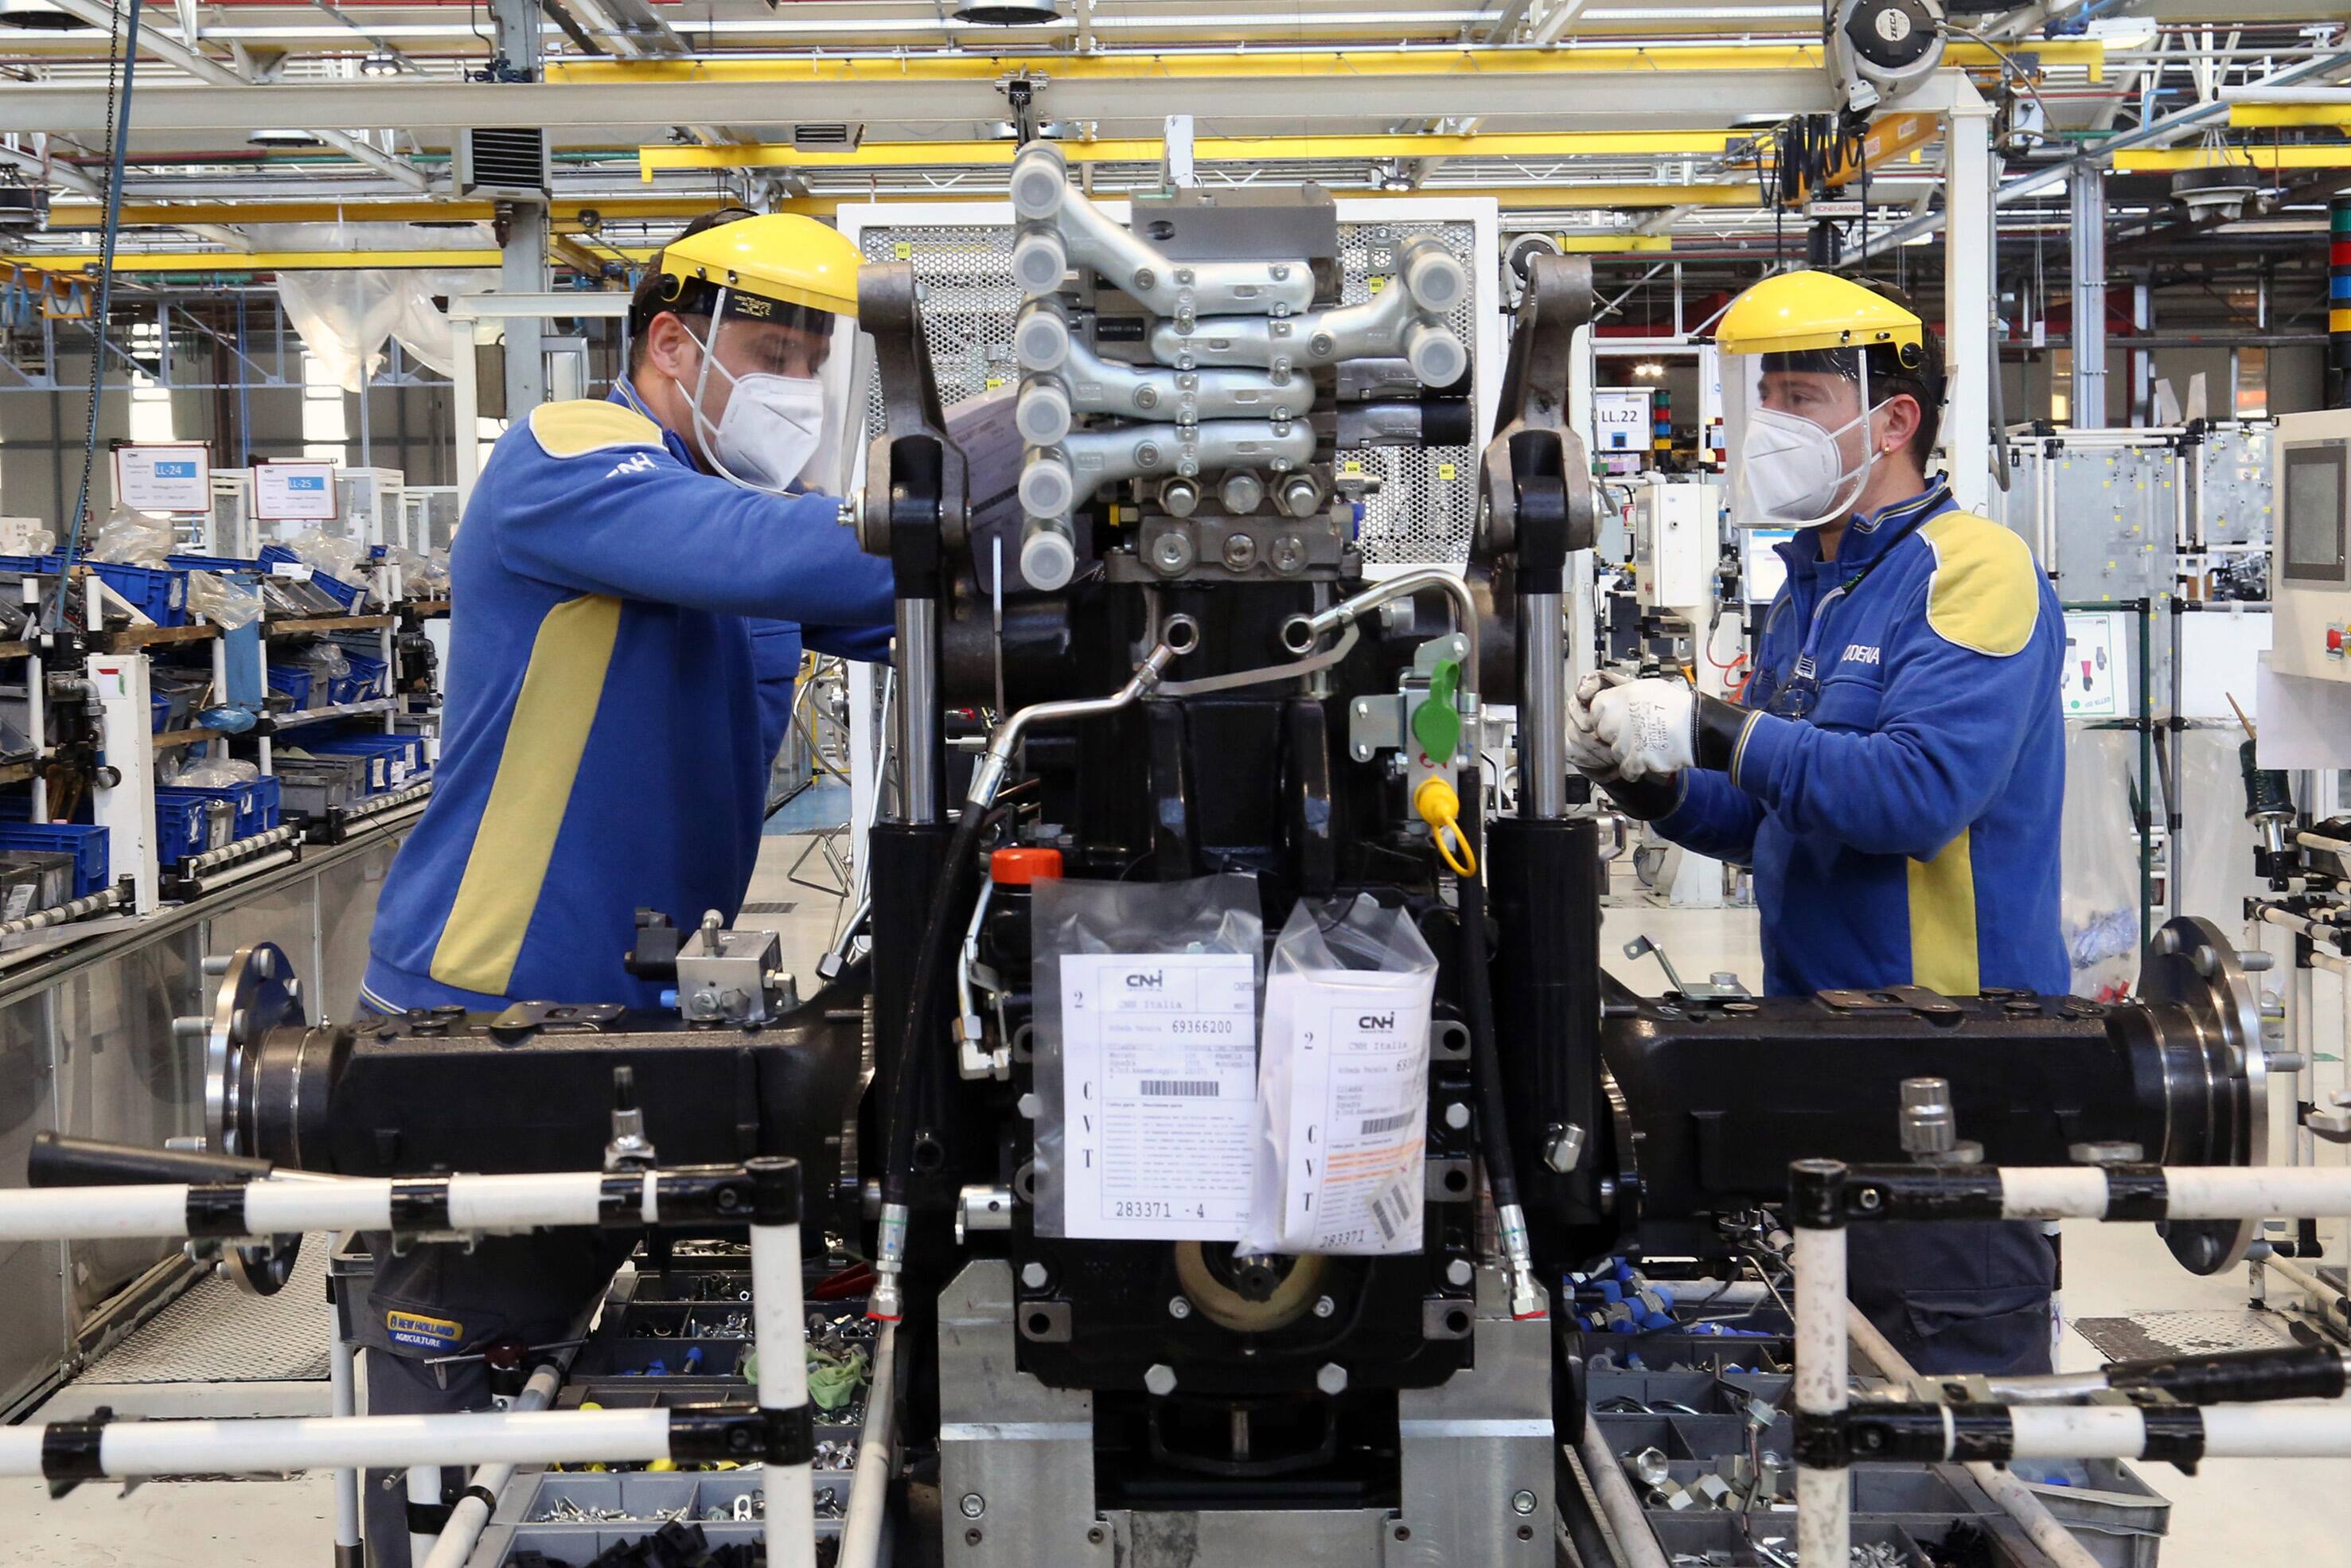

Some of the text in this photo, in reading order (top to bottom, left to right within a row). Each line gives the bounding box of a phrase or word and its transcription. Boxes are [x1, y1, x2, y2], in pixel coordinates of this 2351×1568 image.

[1889, 11, 1898, 38] ZECA
[1601, 410, 1638, 422] LL.22
[155, 465, 181, 475] LL-24
[289, 479, 312, 488] LL-25
[1840, 645, 1880, 665] ODENA
[1074, 992, 1083, 1008] 2
[1172, 1020, 1232, 1034] 69366200
[1304, 1032, 1314, 1050] 2
[1116, 1201, 1172, 1218] 283371
[395, 1332, 441, 1348] AGRICULTURE
